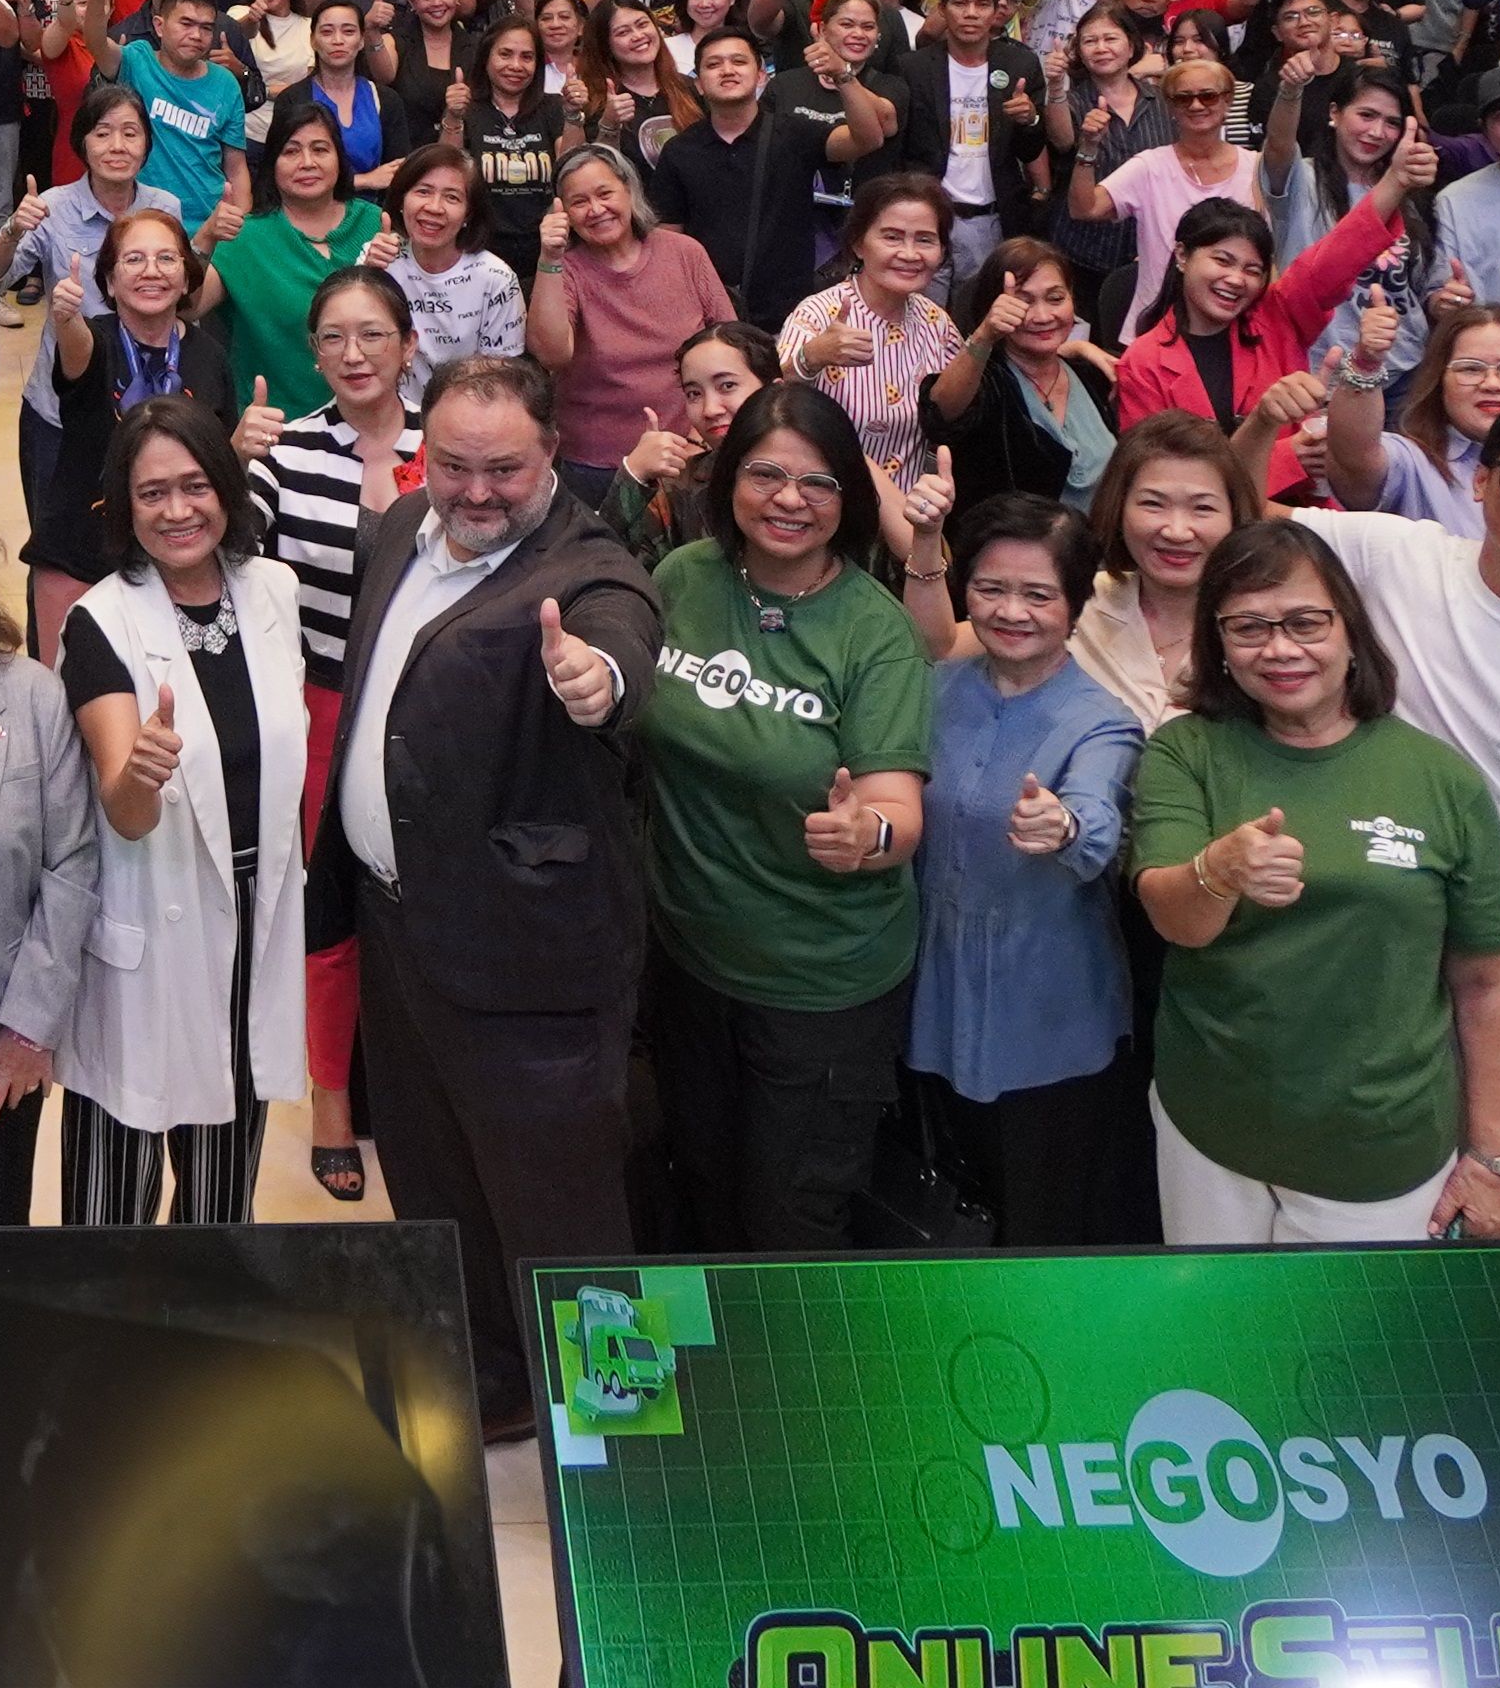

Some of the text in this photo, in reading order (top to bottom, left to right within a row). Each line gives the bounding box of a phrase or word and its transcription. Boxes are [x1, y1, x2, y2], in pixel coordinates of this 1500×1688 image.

[150, 97, 211, 140] PUMA
[655, 645, 823, 720] NEGOSYO
[1350, 818, 1426, 843] NEGOSYO
[982, 1430, 1489, 1532] NEGOSYO
